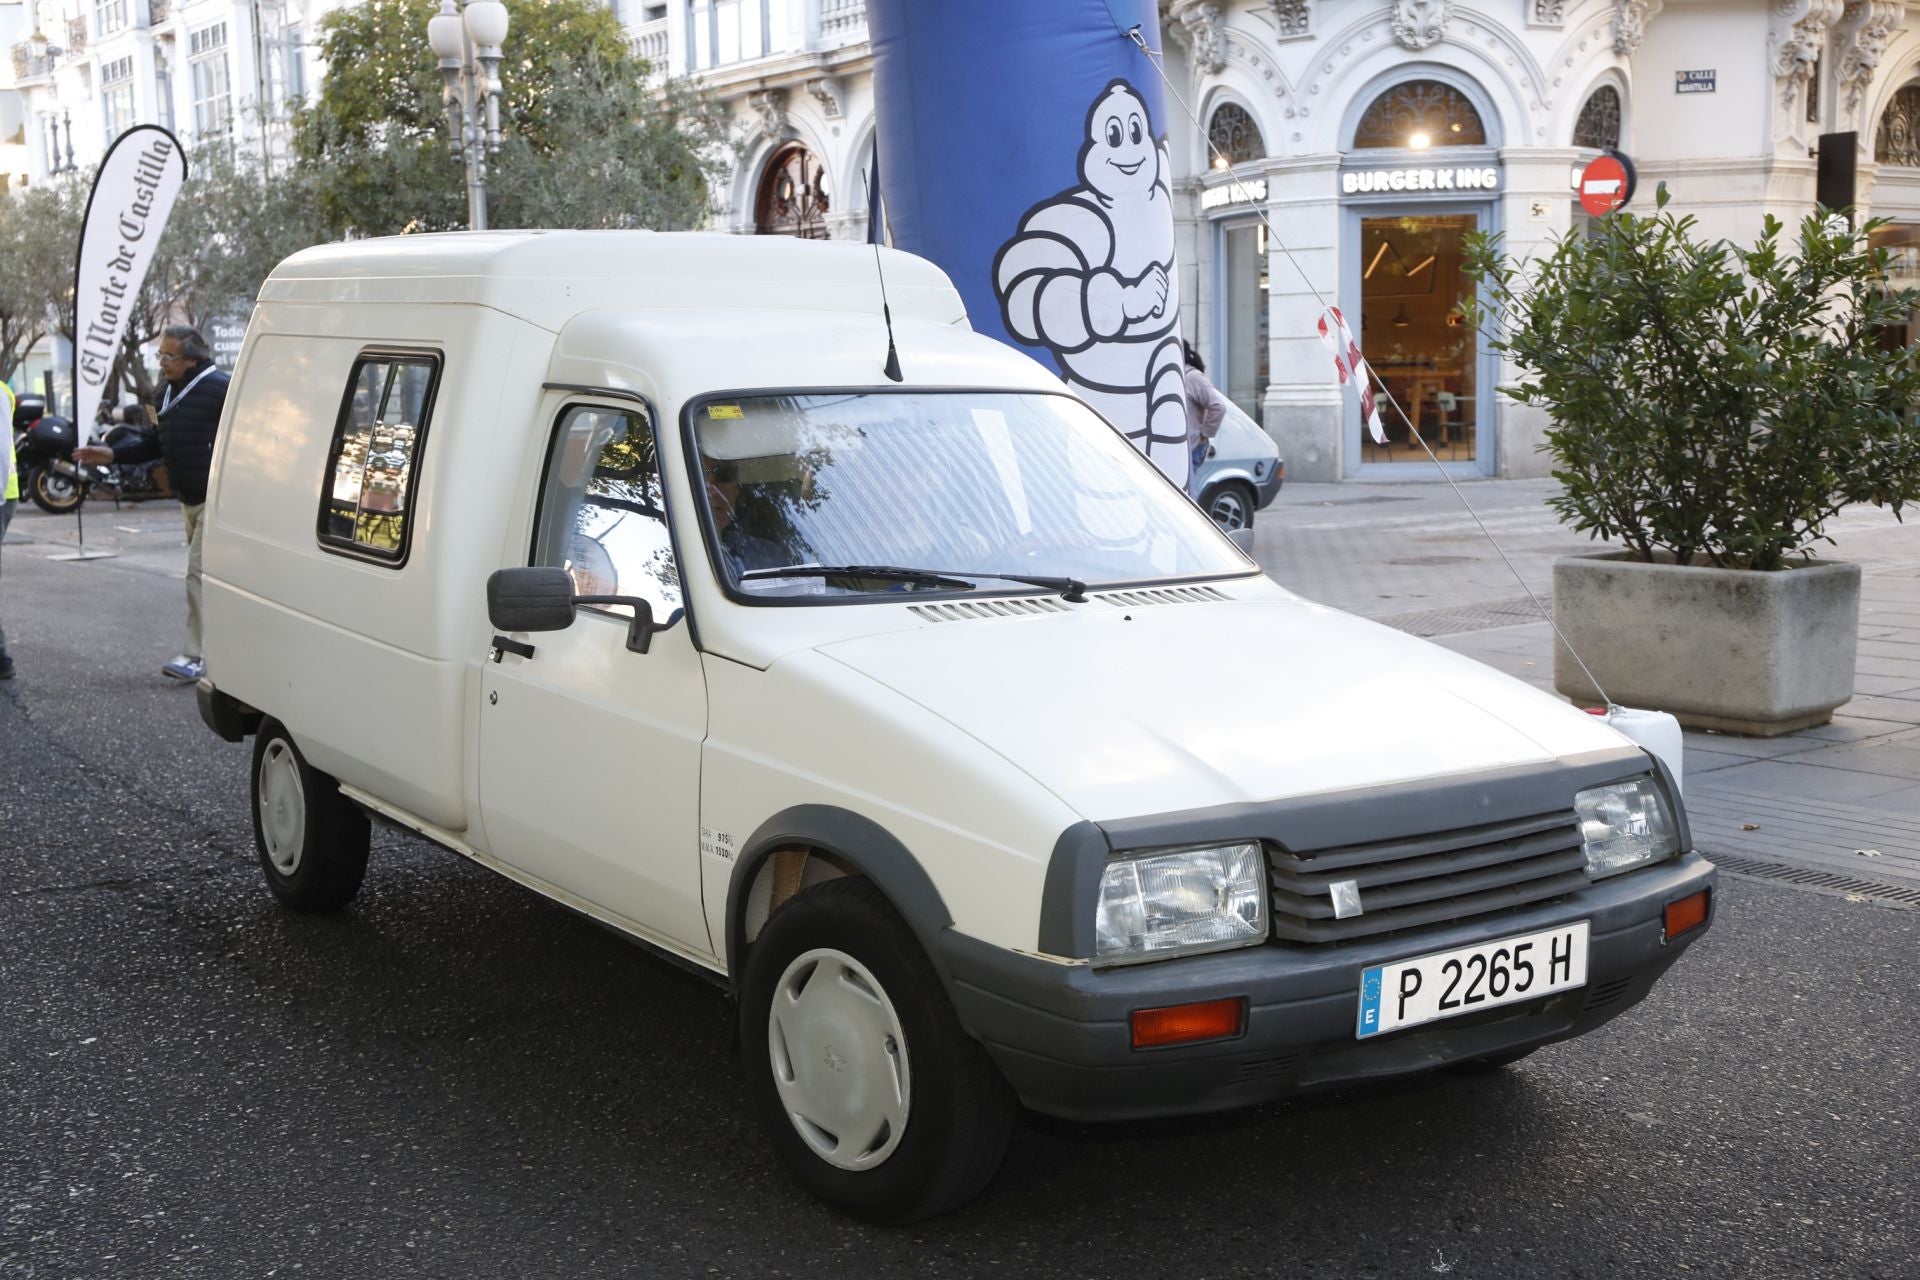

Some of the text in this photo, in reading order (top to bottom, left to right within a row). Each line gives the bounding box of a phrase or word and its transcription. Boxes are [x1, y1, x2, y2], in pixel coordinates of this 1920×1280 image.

[1689, 71, 1714, 80] CALLE
[1342, 168, 1498, 193] BURGER KING
[80, 139, 173, 387] El Norte de Castilla
[1398, 933, 1572, 1021] P 2265 H
[1365, 1008, 1375, 1024] E
